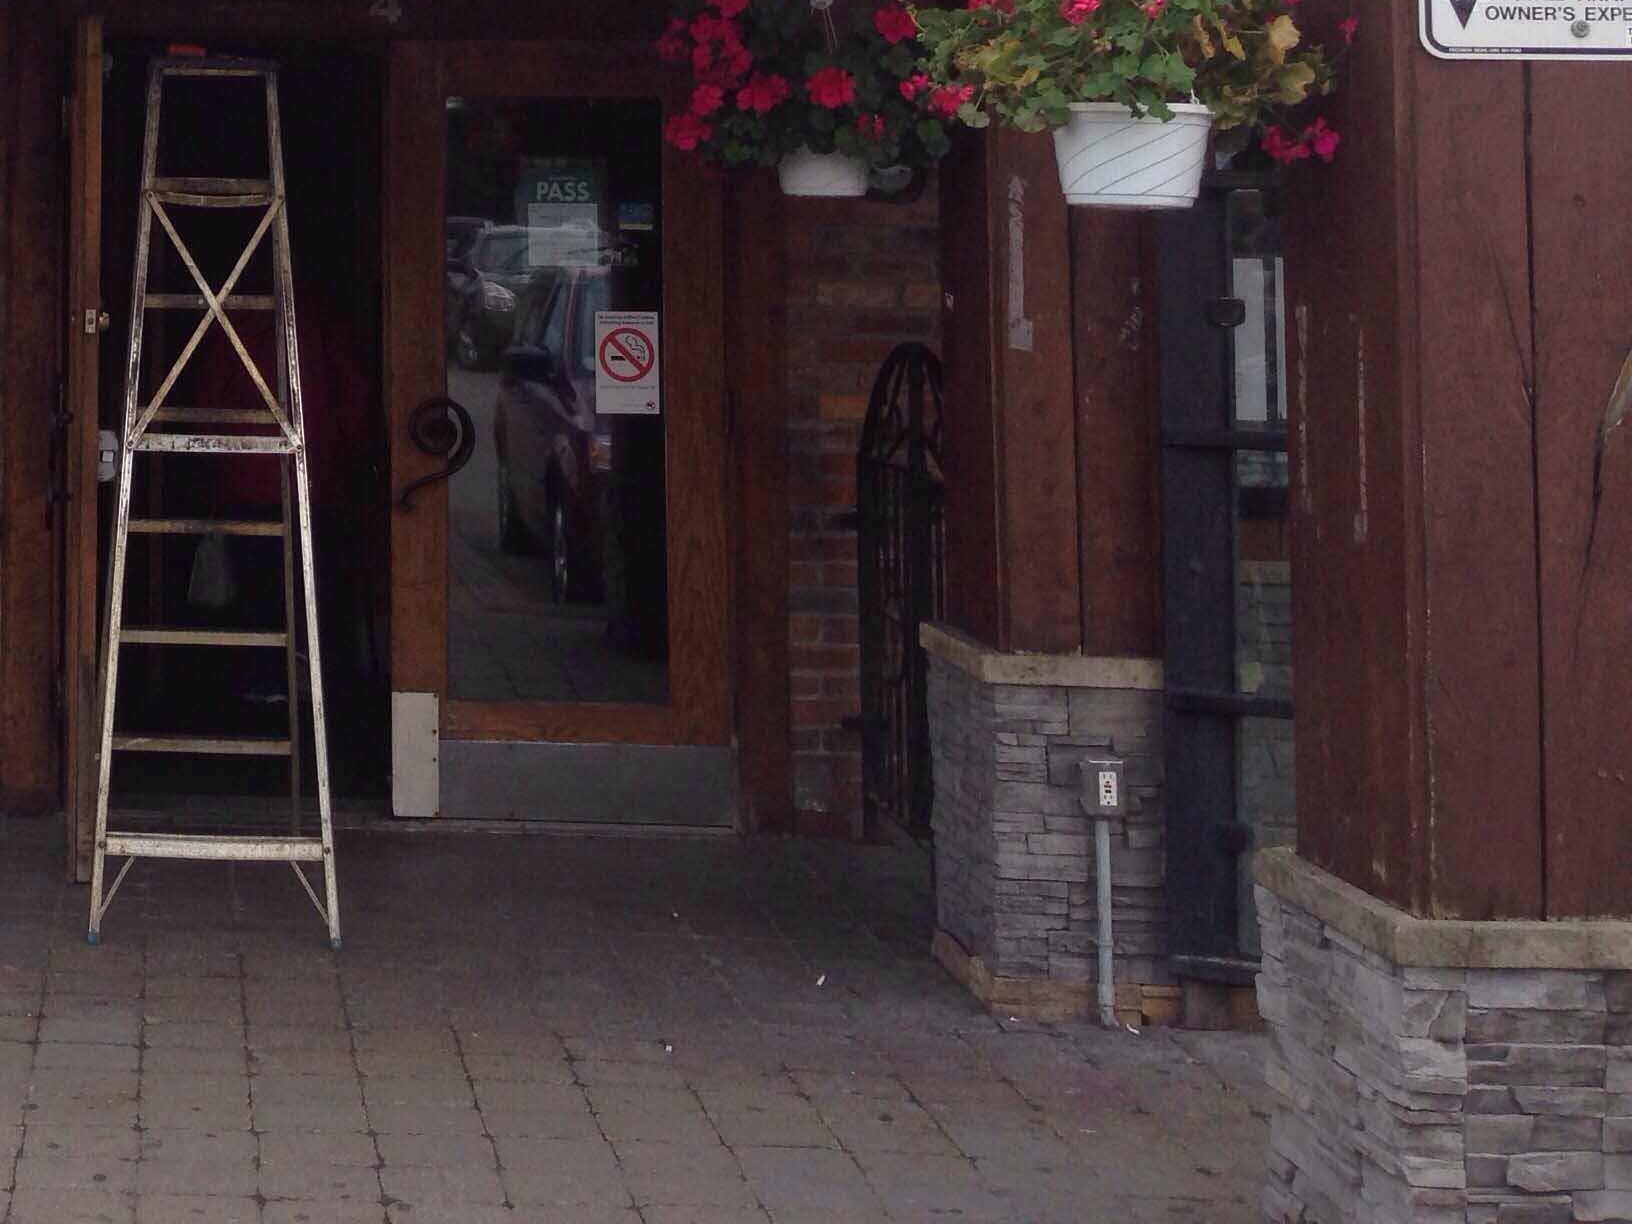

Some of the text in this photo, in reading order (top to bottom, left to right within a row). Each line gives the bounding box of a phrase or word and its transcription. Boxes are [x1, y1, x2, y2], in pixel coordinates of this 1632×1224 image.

[1485, 6, 1632, 22] OWNER'S EXPE
[536, 181, 590, 201] PASS
